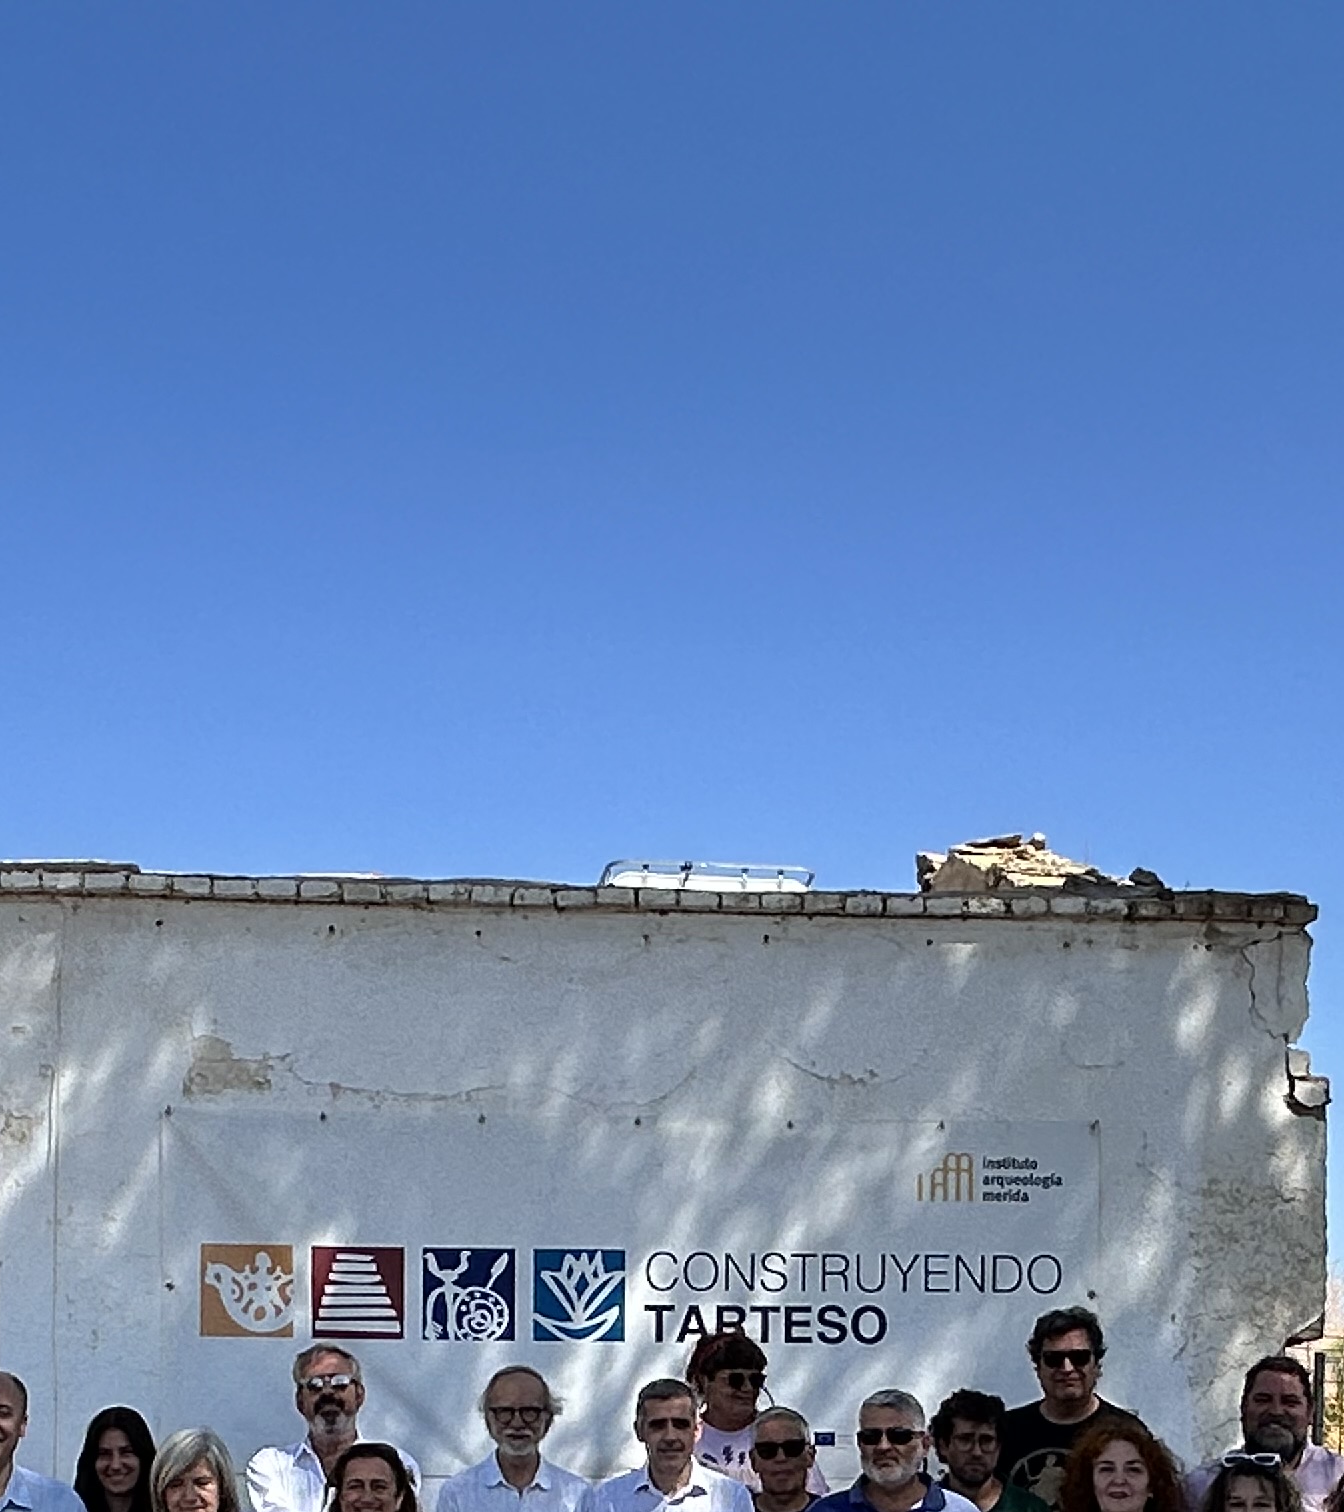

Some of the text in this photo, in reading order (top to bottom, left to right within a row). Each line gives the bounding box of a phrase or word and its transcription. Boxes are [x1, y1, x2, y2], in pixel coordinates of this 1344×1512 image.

[981, 1156, 1038, 1170] instituto
[645, 1251, 1064, 1295] CONSTRUYENDO
[643, 1303, 888, 1346] TARTESO
